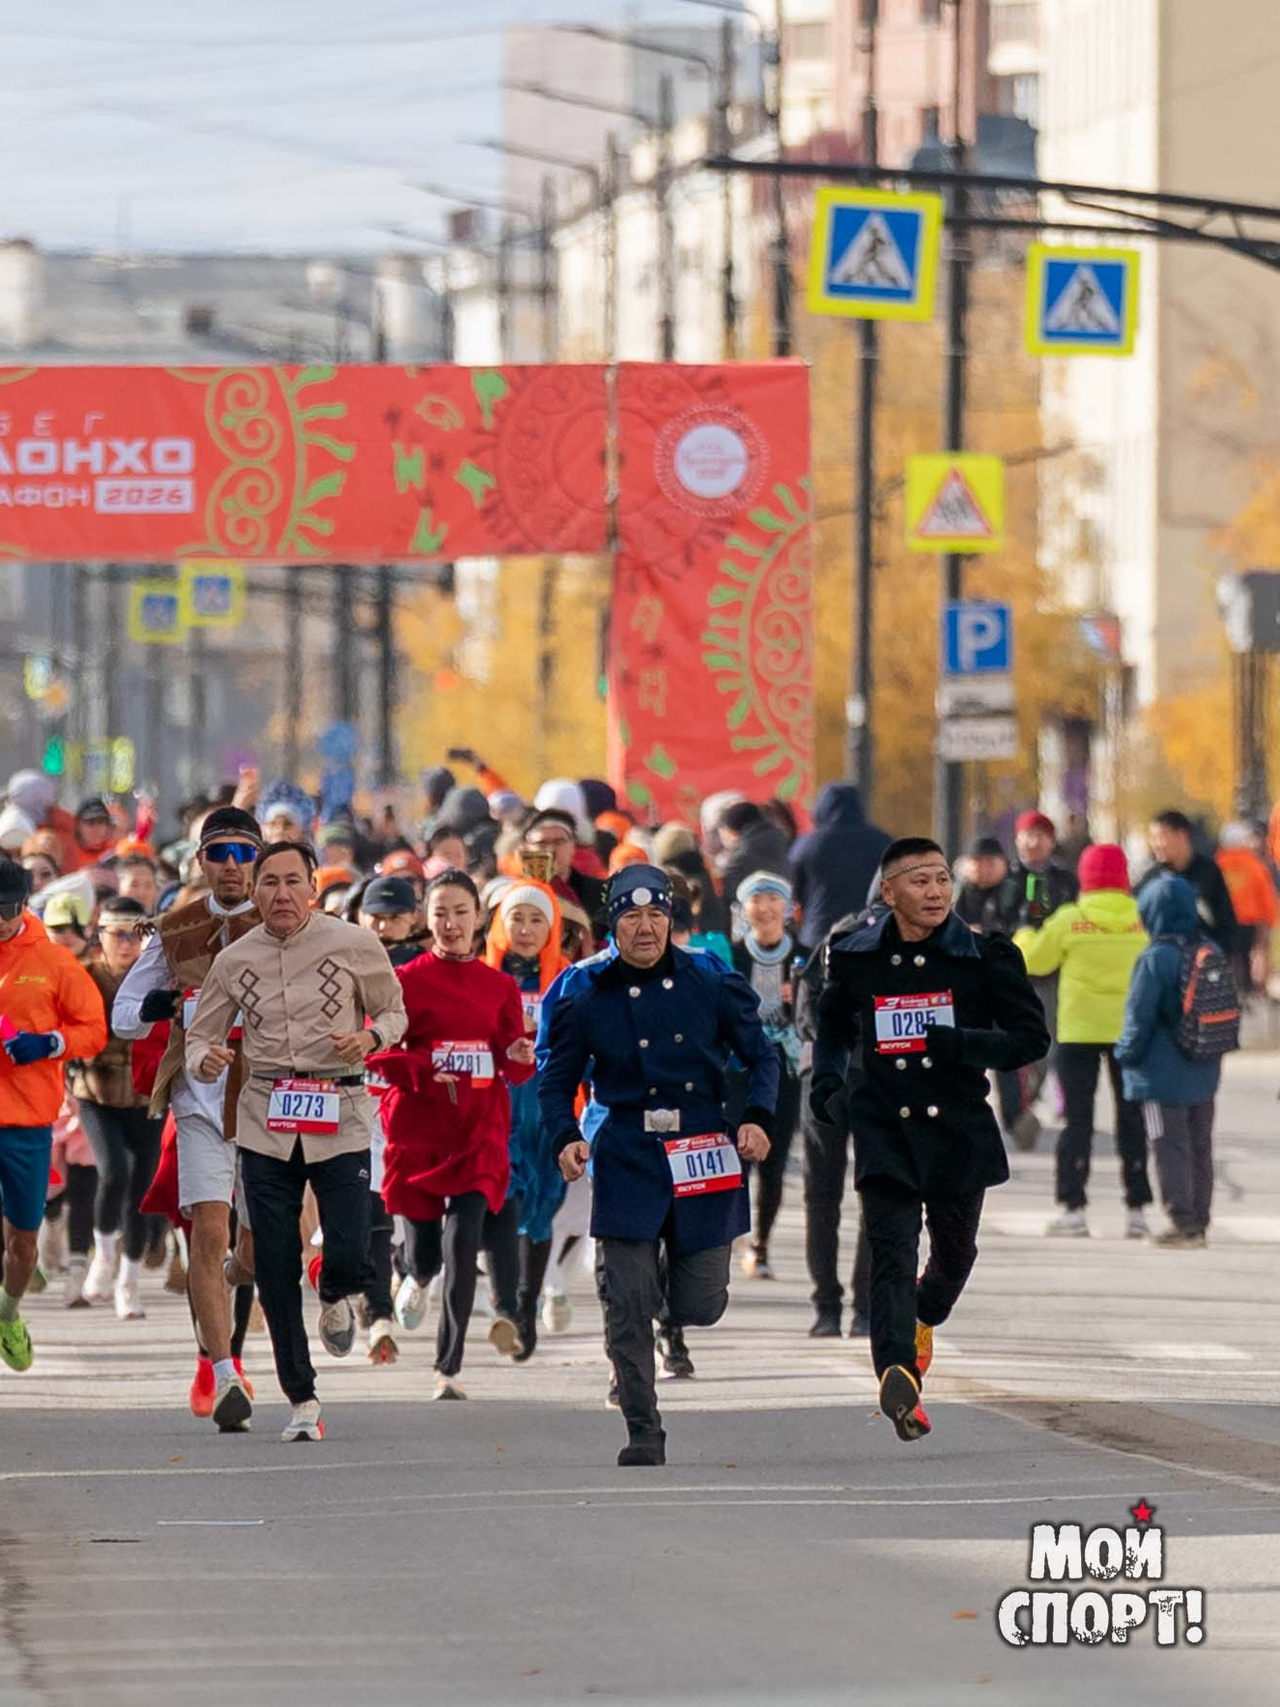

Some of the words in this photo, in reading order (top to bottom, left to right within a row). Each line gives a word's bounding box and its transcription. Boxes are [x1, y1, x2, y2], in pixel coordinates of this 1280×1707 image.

[104, 487, 184, 505] 2026
[958, 611, 1003, 671] P
[282, 1093, 325, 1118] 0273
[685, 1149, 725, 1179] 0141
